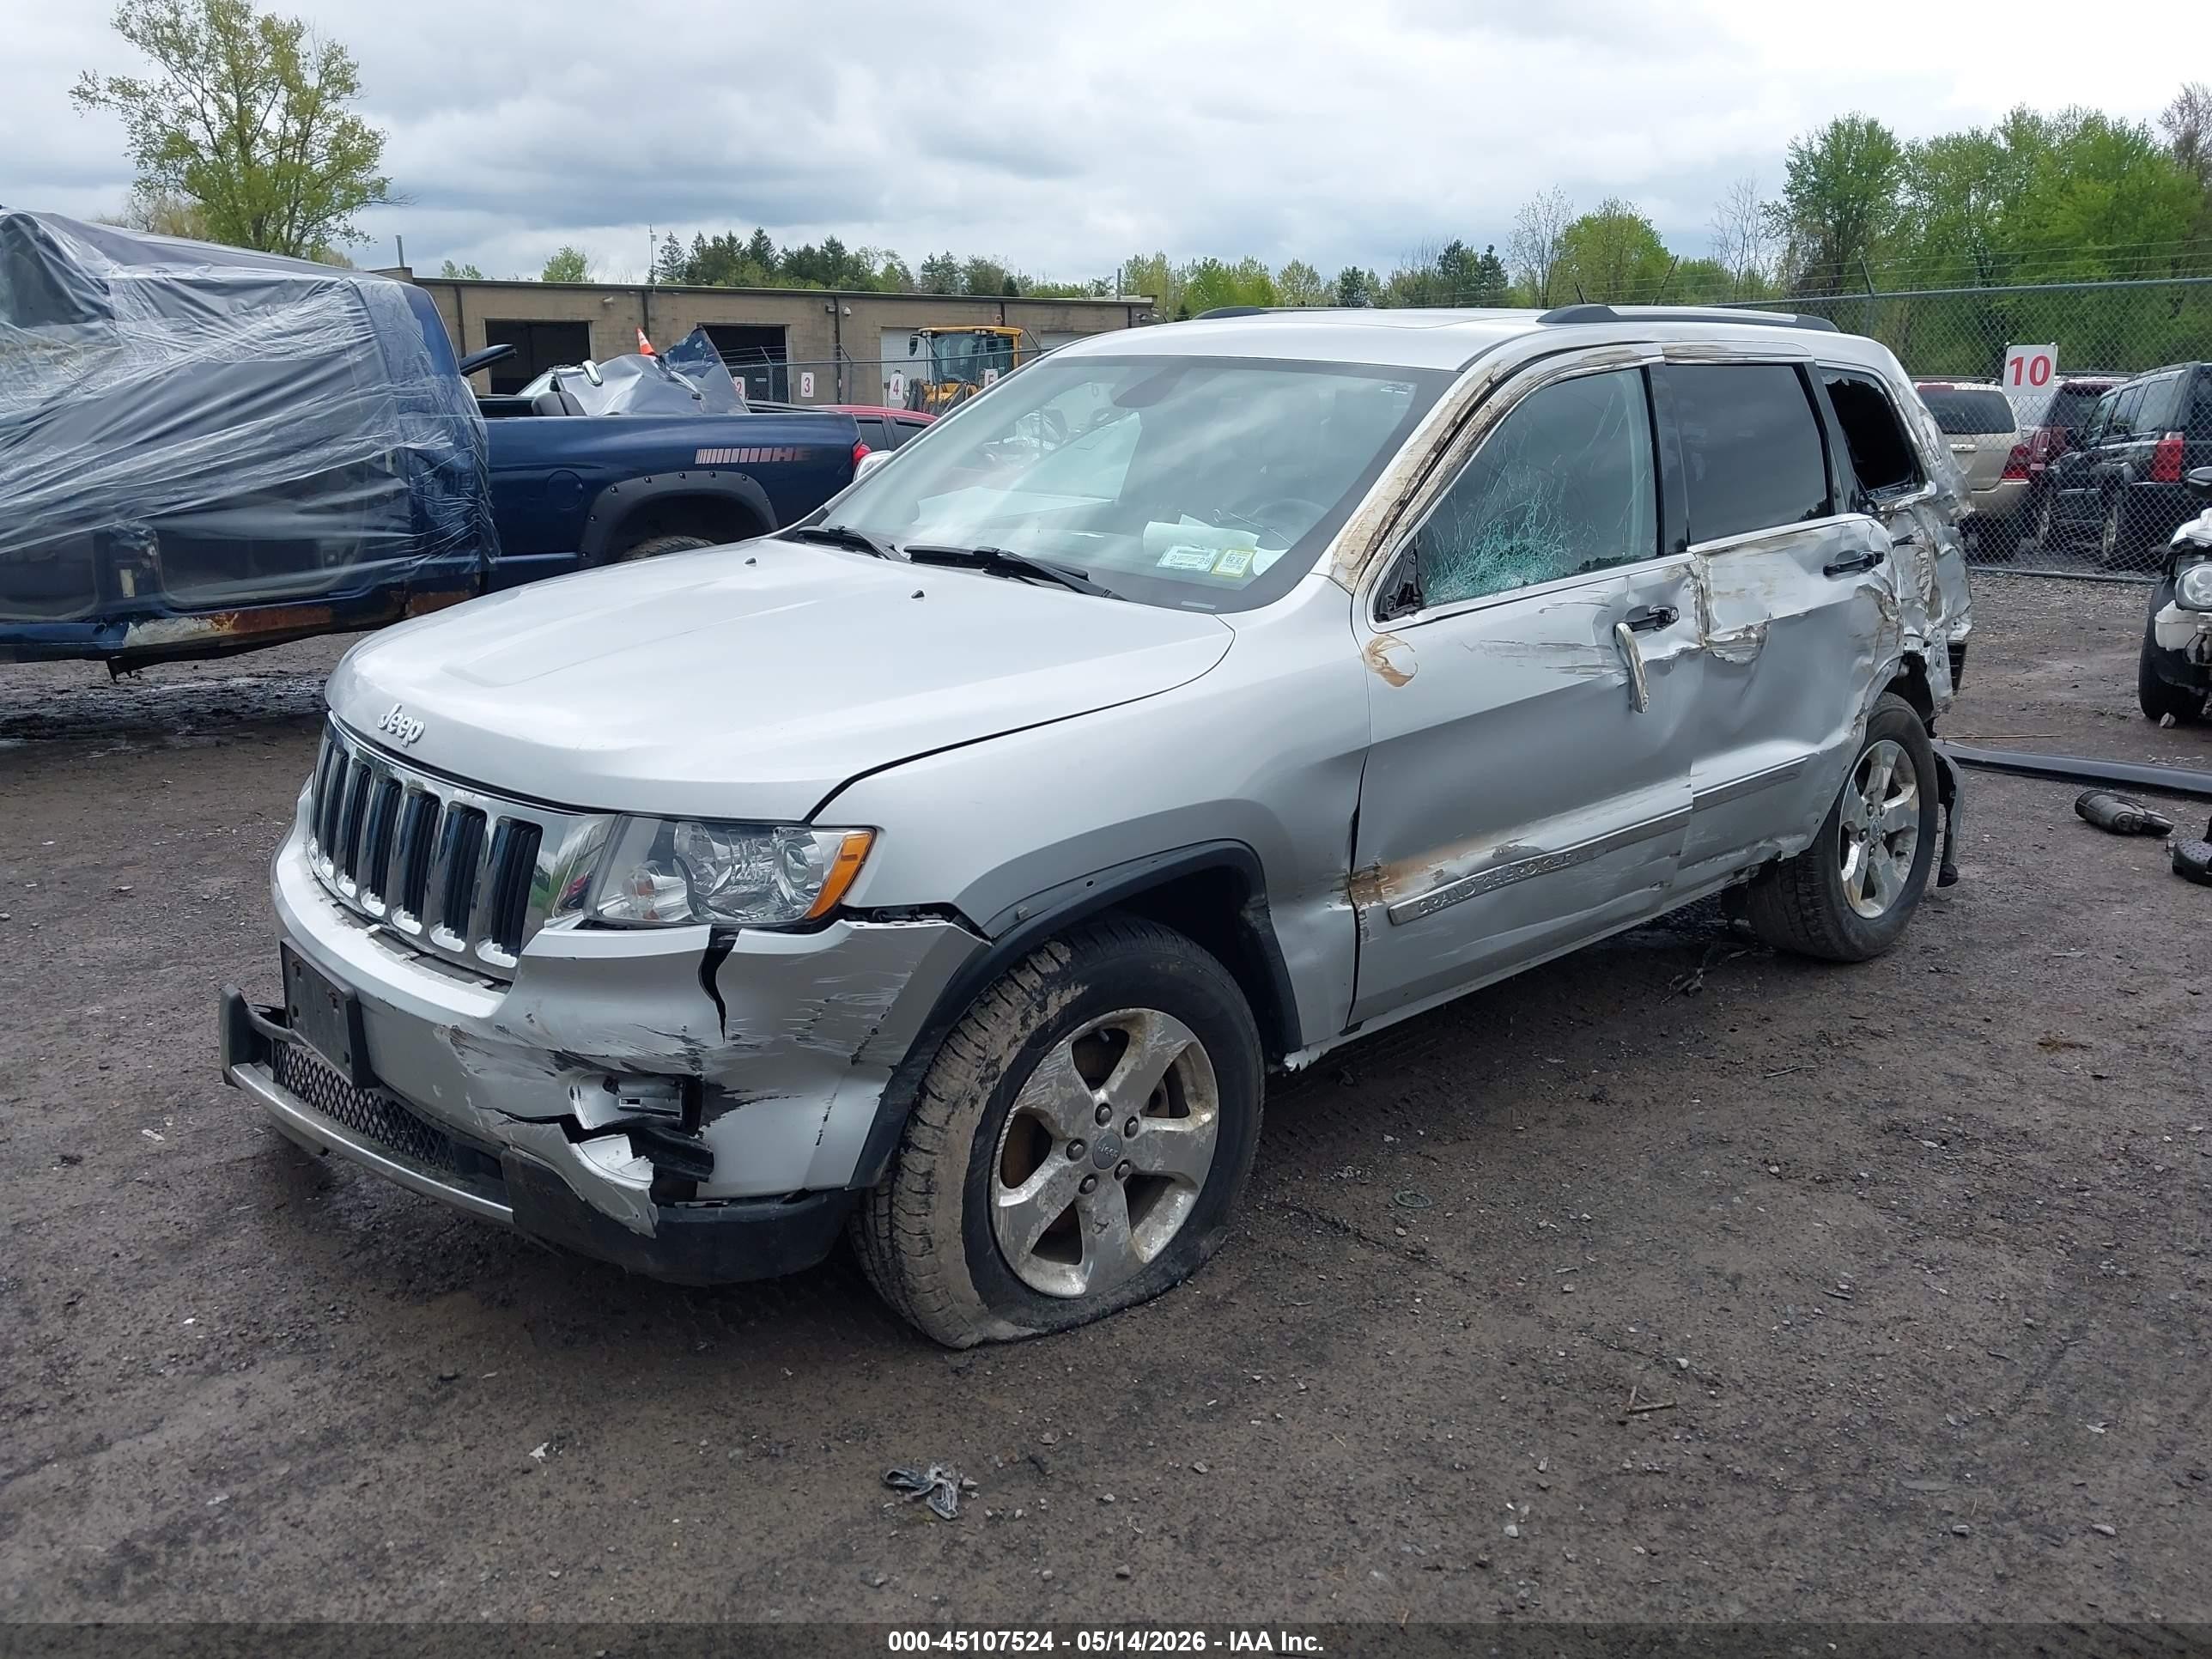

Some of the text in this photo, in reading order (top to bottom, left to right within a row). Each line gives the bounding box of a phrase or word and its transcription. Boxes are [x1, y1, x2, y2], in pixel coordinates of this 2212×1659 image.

[804, 377, 811, 393] 3
[2009, 356, 2051, 386] 10
[892, 379, 899, 395] 4
[378, 703, 425, 748] Jeep
[1419, 878, 1477, 915] GRAND
